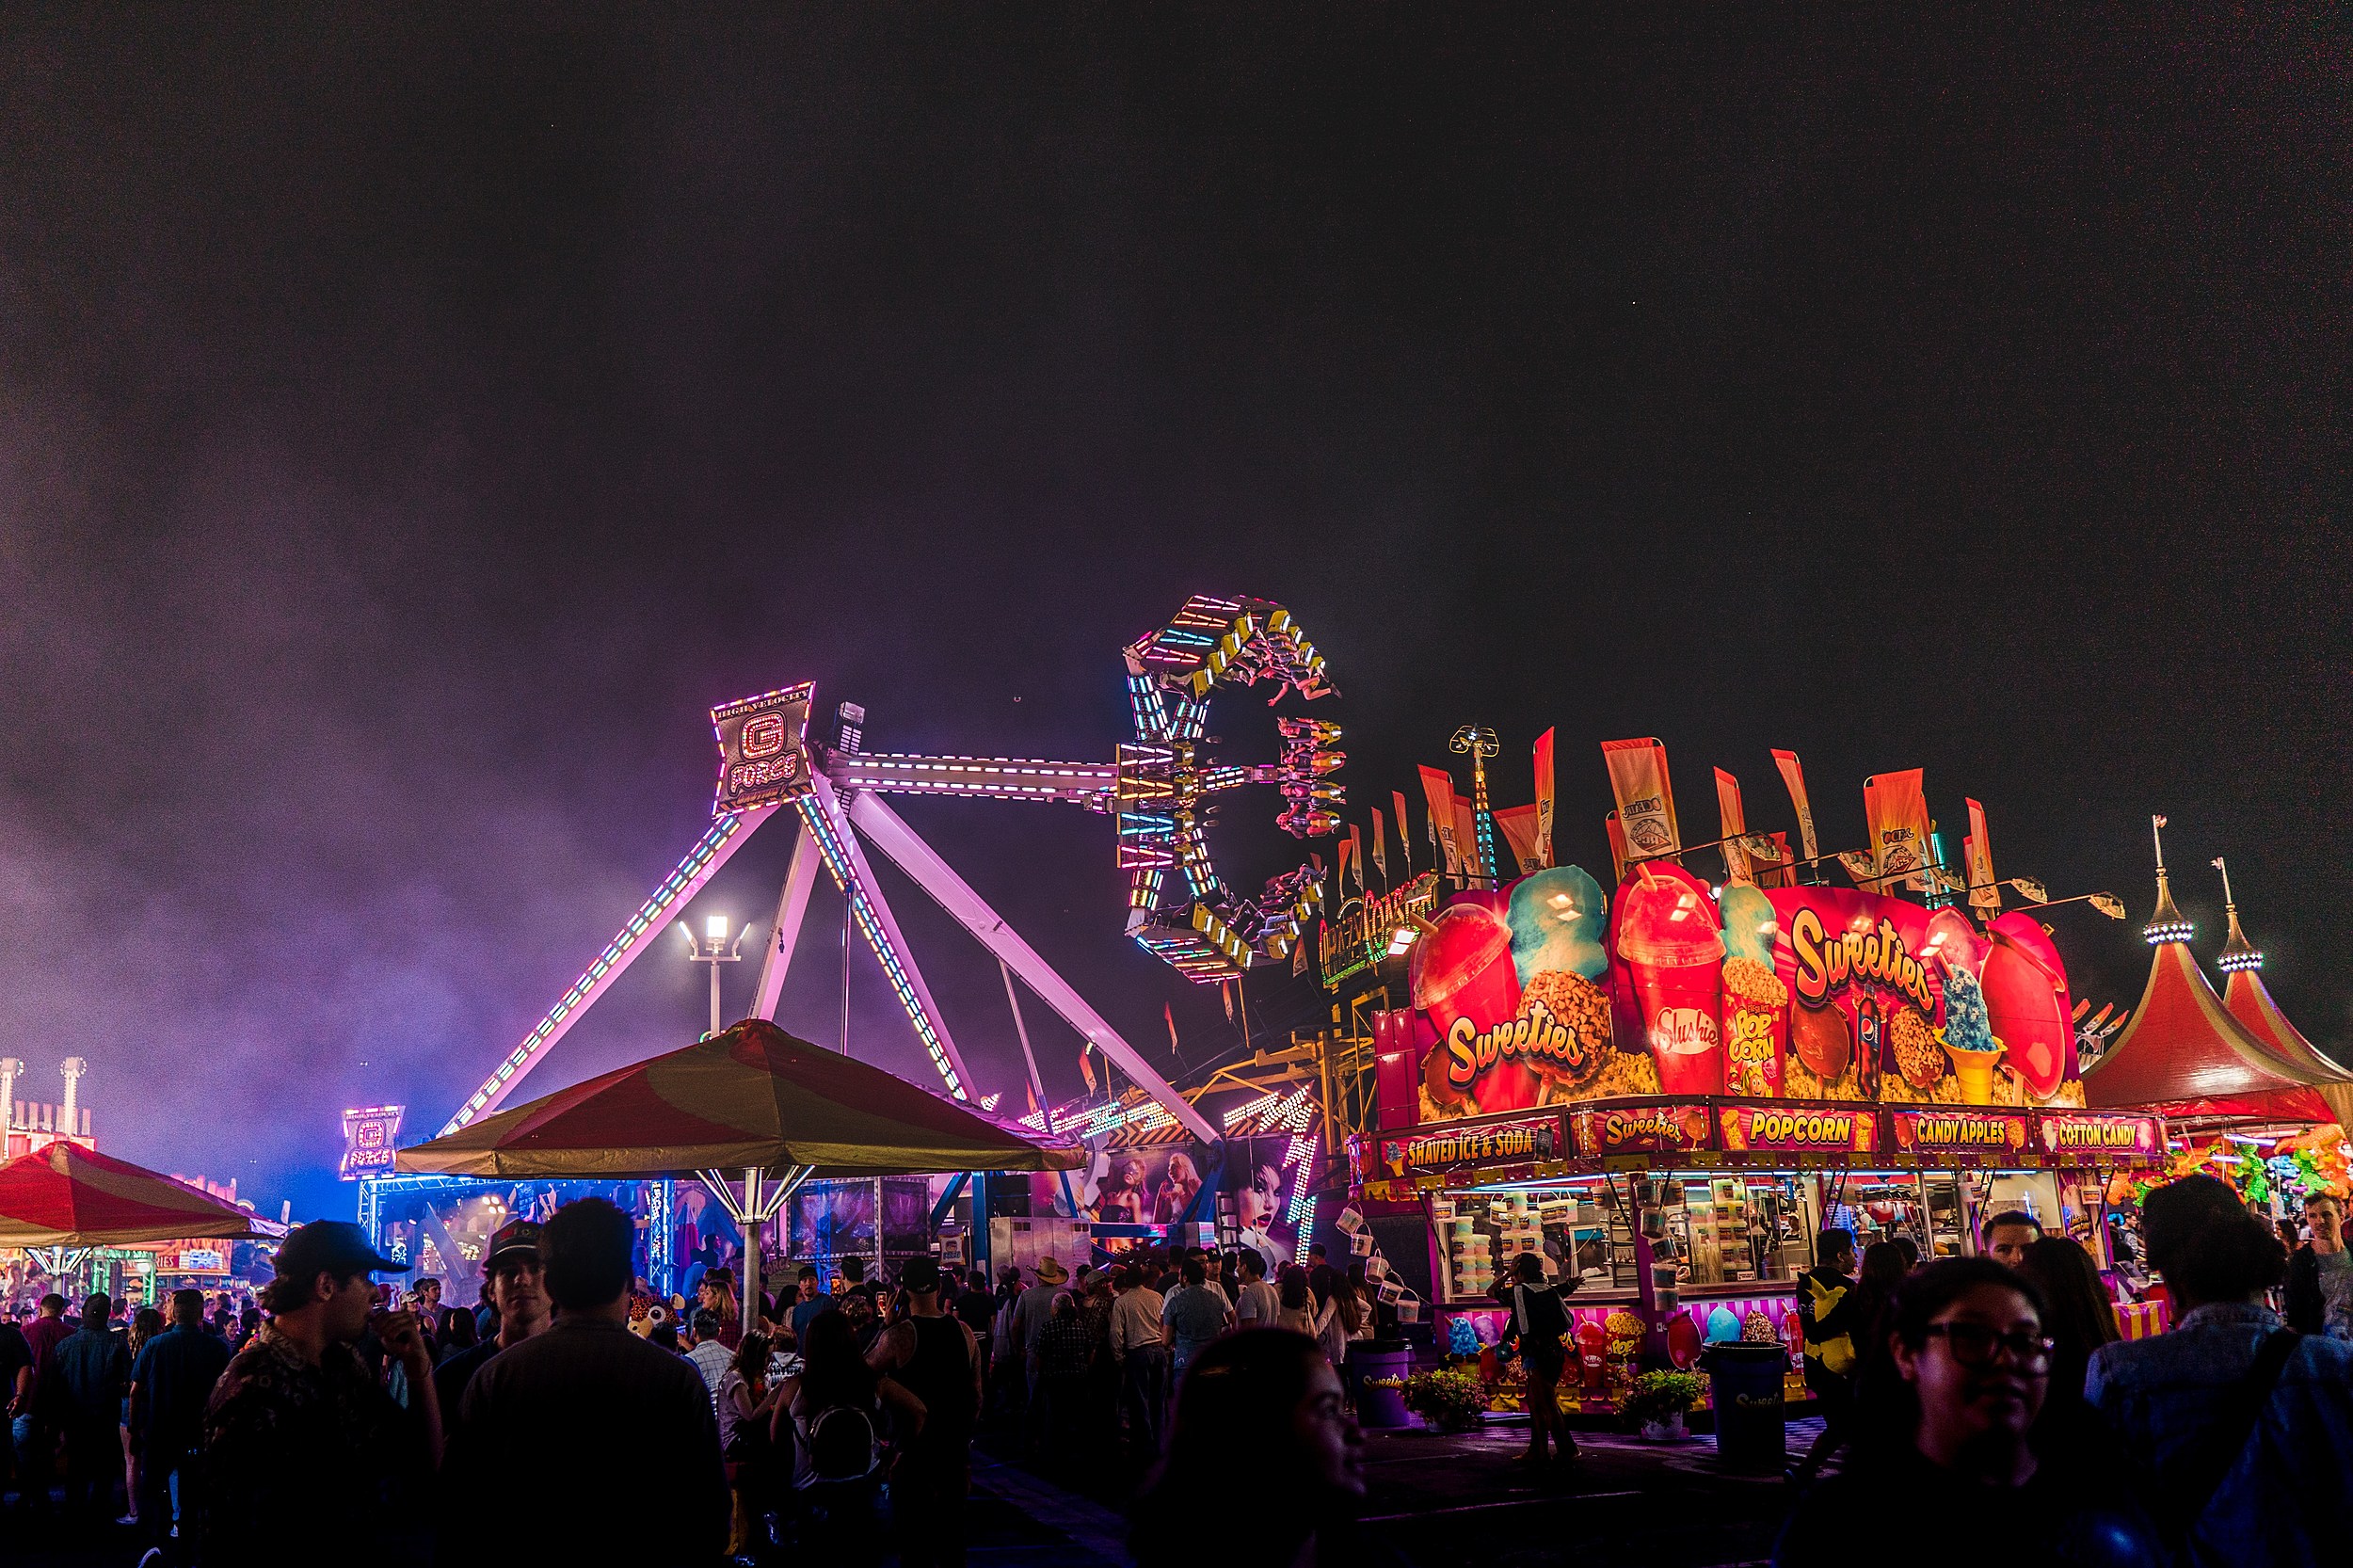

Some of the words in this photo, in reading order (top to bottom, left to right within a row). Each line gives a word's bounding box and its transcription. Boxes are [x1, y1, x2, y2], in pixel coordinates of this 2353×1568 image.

[716, 705, 749, 718] HIGH
[751, 689, 810, 710] VELOCITY
[741, 712, 784, 760] G
[729, 752, 798, 795] FORCE
[1792, 908, 1935, 1012] Sweeties
[1449, 1000, 1584, 1085] Sweeties
[1657, 1009, 1718, 1053] Slushie
[1736, 1009, 1772, 1043] POP
[1729, 1035, 1775, 1063] CORN
[359, 1120, 385, 1148] G
[1606, 1111, 1684, 1146] Sweeties
[1750, 1112, 1851, 1144] POPCORN
[1916, 1118, 1957, 1145] CANDY
[1959, 1118, 2006, 1145] APPLES
[2058, 1124, 2102, 1148] COTTON
[2102, 1124, 2137, 1148] CANDY
[349, 1148, 391, 1169] FORCE
[1407, 1138, 1457, 1167] SHAVED
[1459, 1135, 1479, 1160] ICE
[1481, 1136, 1492, 1157] &
[1495, 1128, 1533, 1157] SODA
[1612, 1339, 1635, 1354] POP
